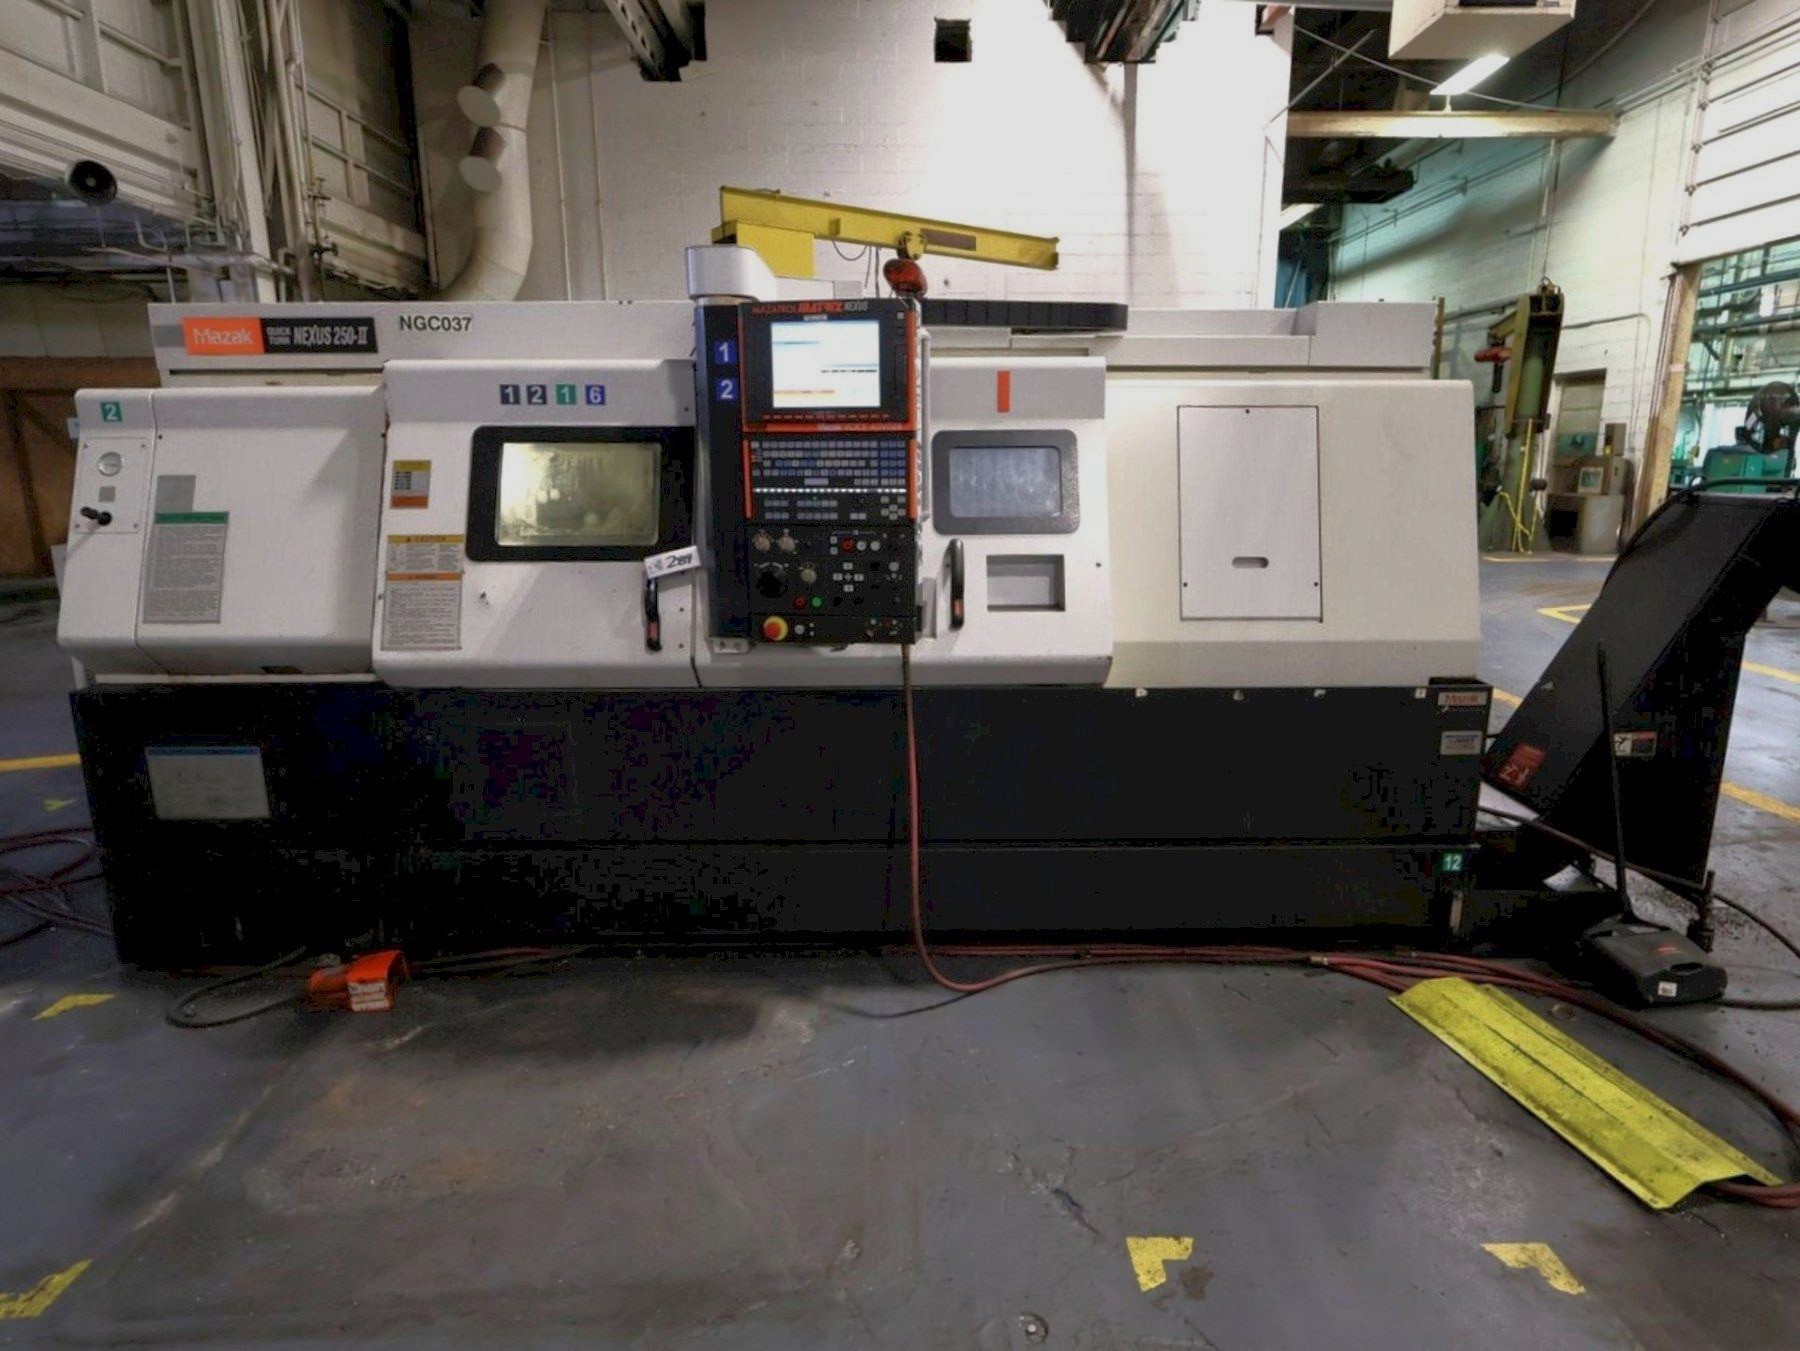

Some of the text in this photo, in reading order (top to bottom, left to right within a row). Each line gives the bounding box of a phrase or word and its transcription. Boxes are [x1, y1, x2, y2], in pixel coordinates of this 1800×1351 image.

[266, 326, 291, 336] QUICK
[399, 315, 473, 332] NGC037
[192, 327, 253, 346] Mazak
[268, 336, 291, 345] TURN
[294, 325, 332, 347] NEXUS
[718, 342, 729, 362] 1
[720, 379, 734, 400] 2
[104, 404, 119, 420] 2
[1445, 854, 1462, 870] 12
